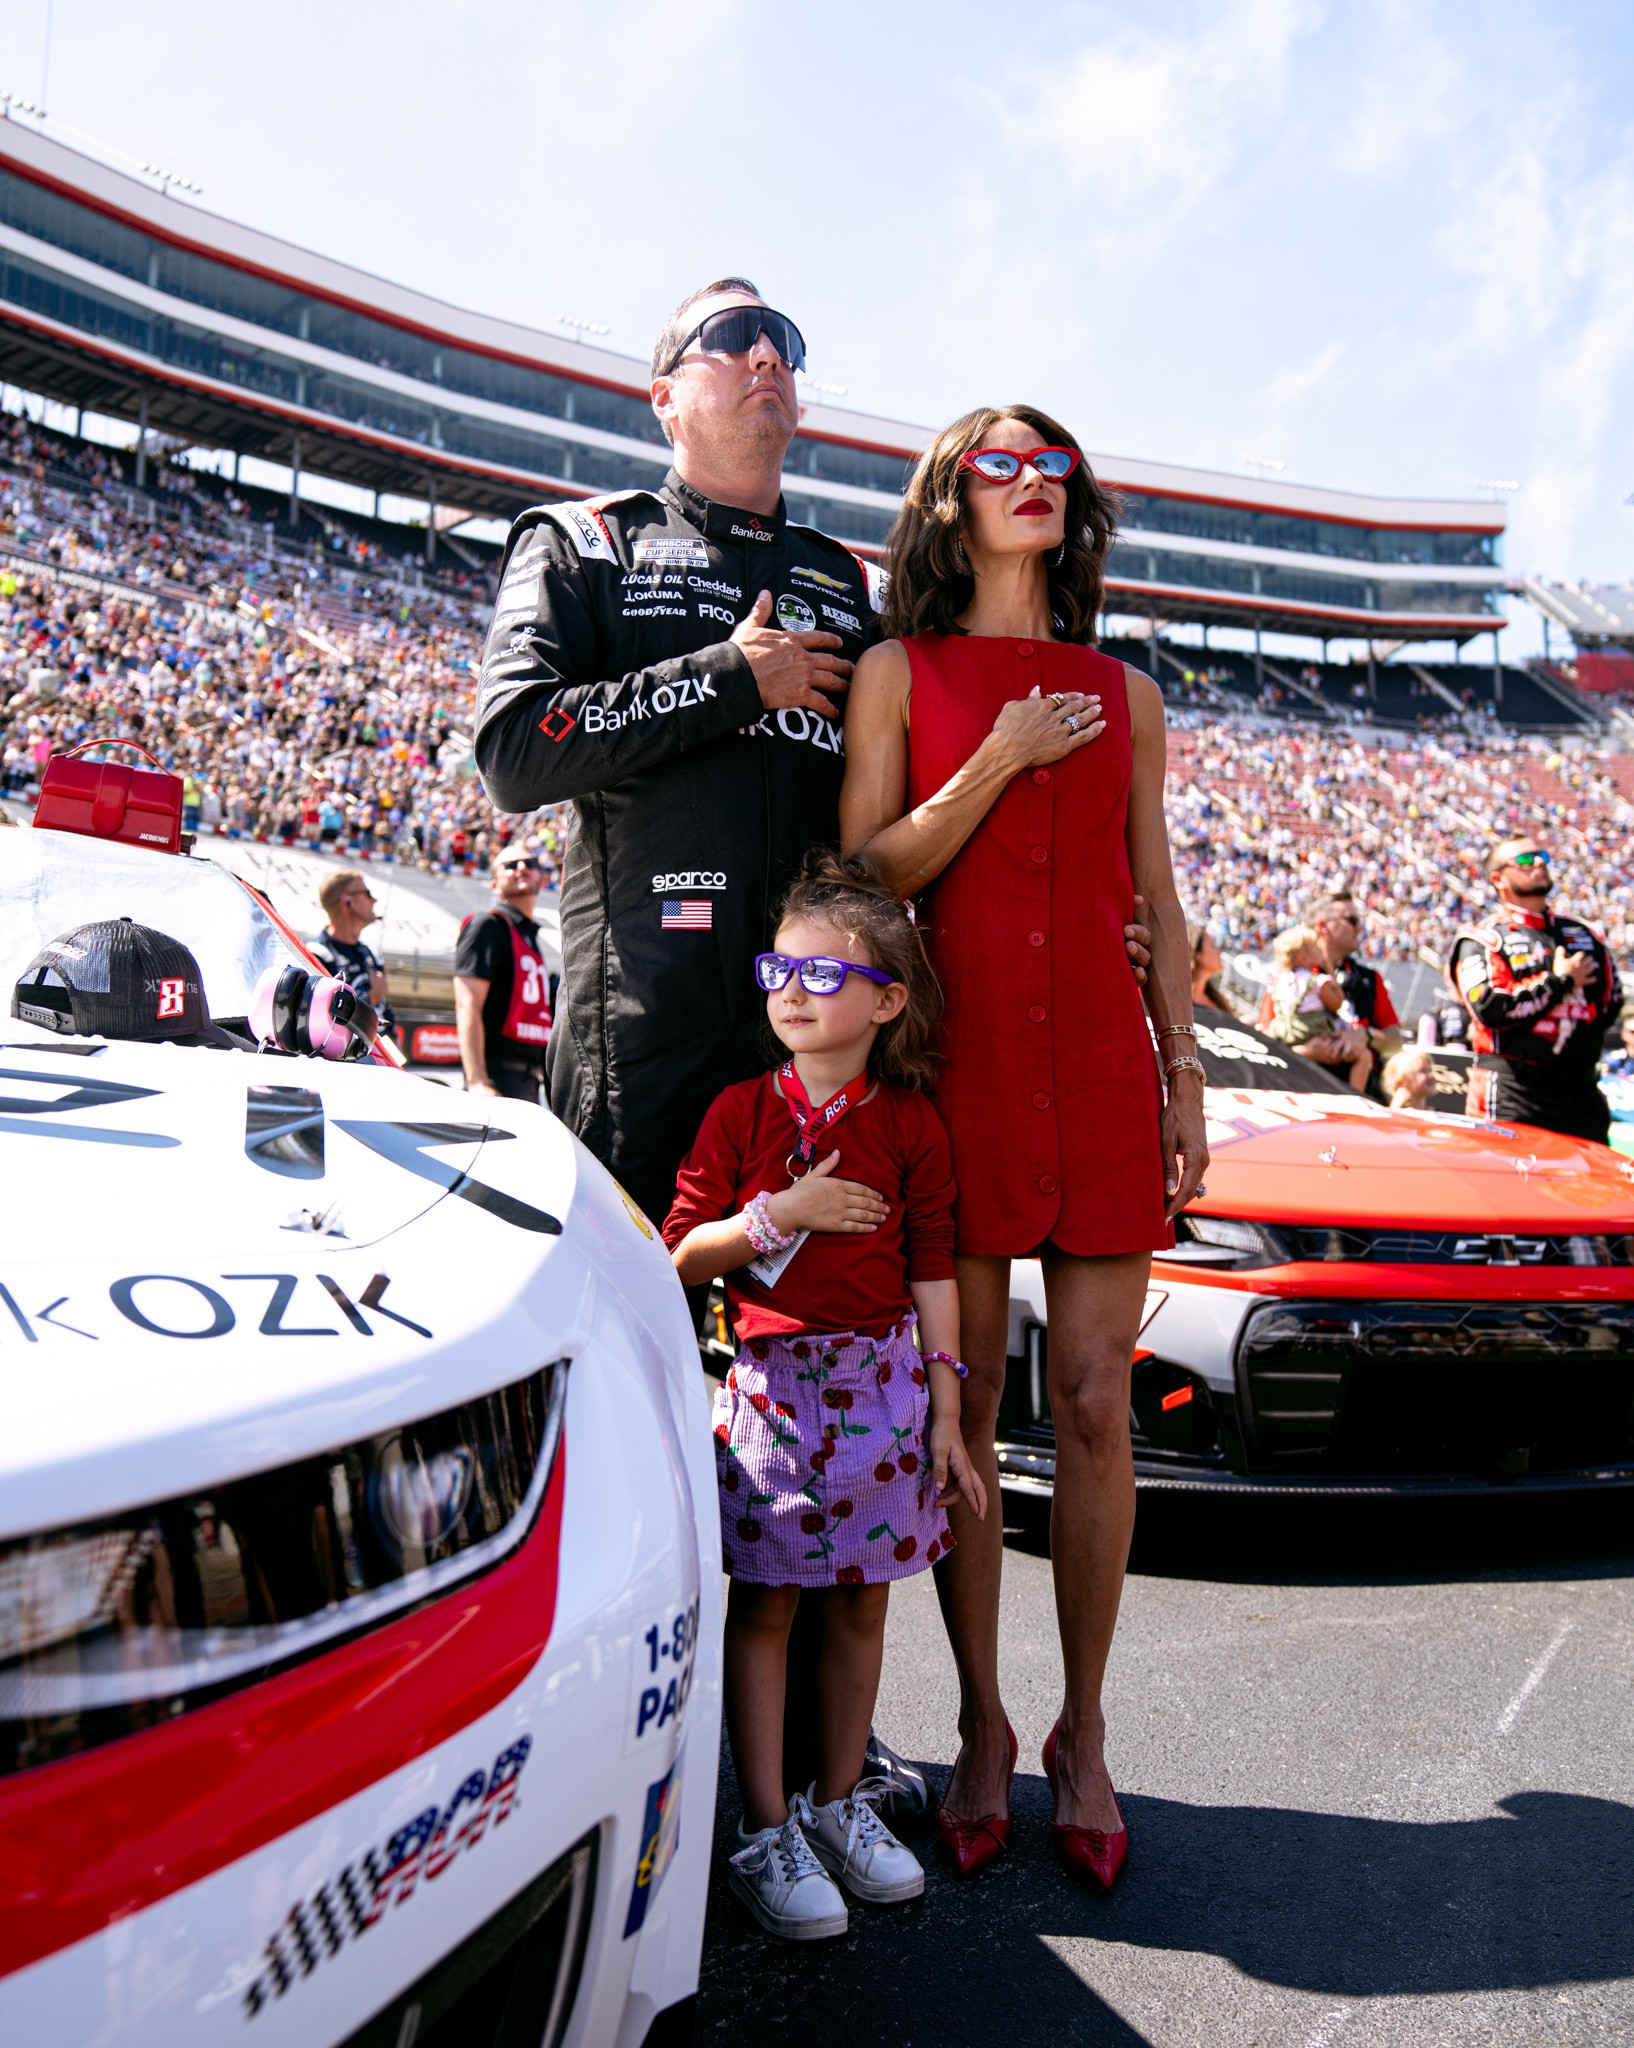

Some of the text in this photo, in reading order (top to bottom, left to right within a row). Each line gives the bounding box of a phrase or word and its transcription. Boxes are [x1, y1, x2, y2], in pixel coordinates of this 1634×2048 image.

[656, 540, 694, 548] NASCAR
[730, 524, 774, 542] Bank OZK
[620, 573, 683, 585] LUCAS OIL
[687, 575, 742, 598] Cheddar's
[790, 578, 856, 606] CHEVROLET
[622, 605, 687, 618] GOODYEAR
[698, 603, 735, 625] FICO
[821, 604, 863, 630] REBEL
[584, 694, 652, 733] Bank
[651, 673, 717, 714] OZK
[651, 871, 727, 892] sparco
[157, 976, 185, 1019] 8
[825, 1093, 848, 1123] RCR
[108, 1273, 434, 1339] OZK
